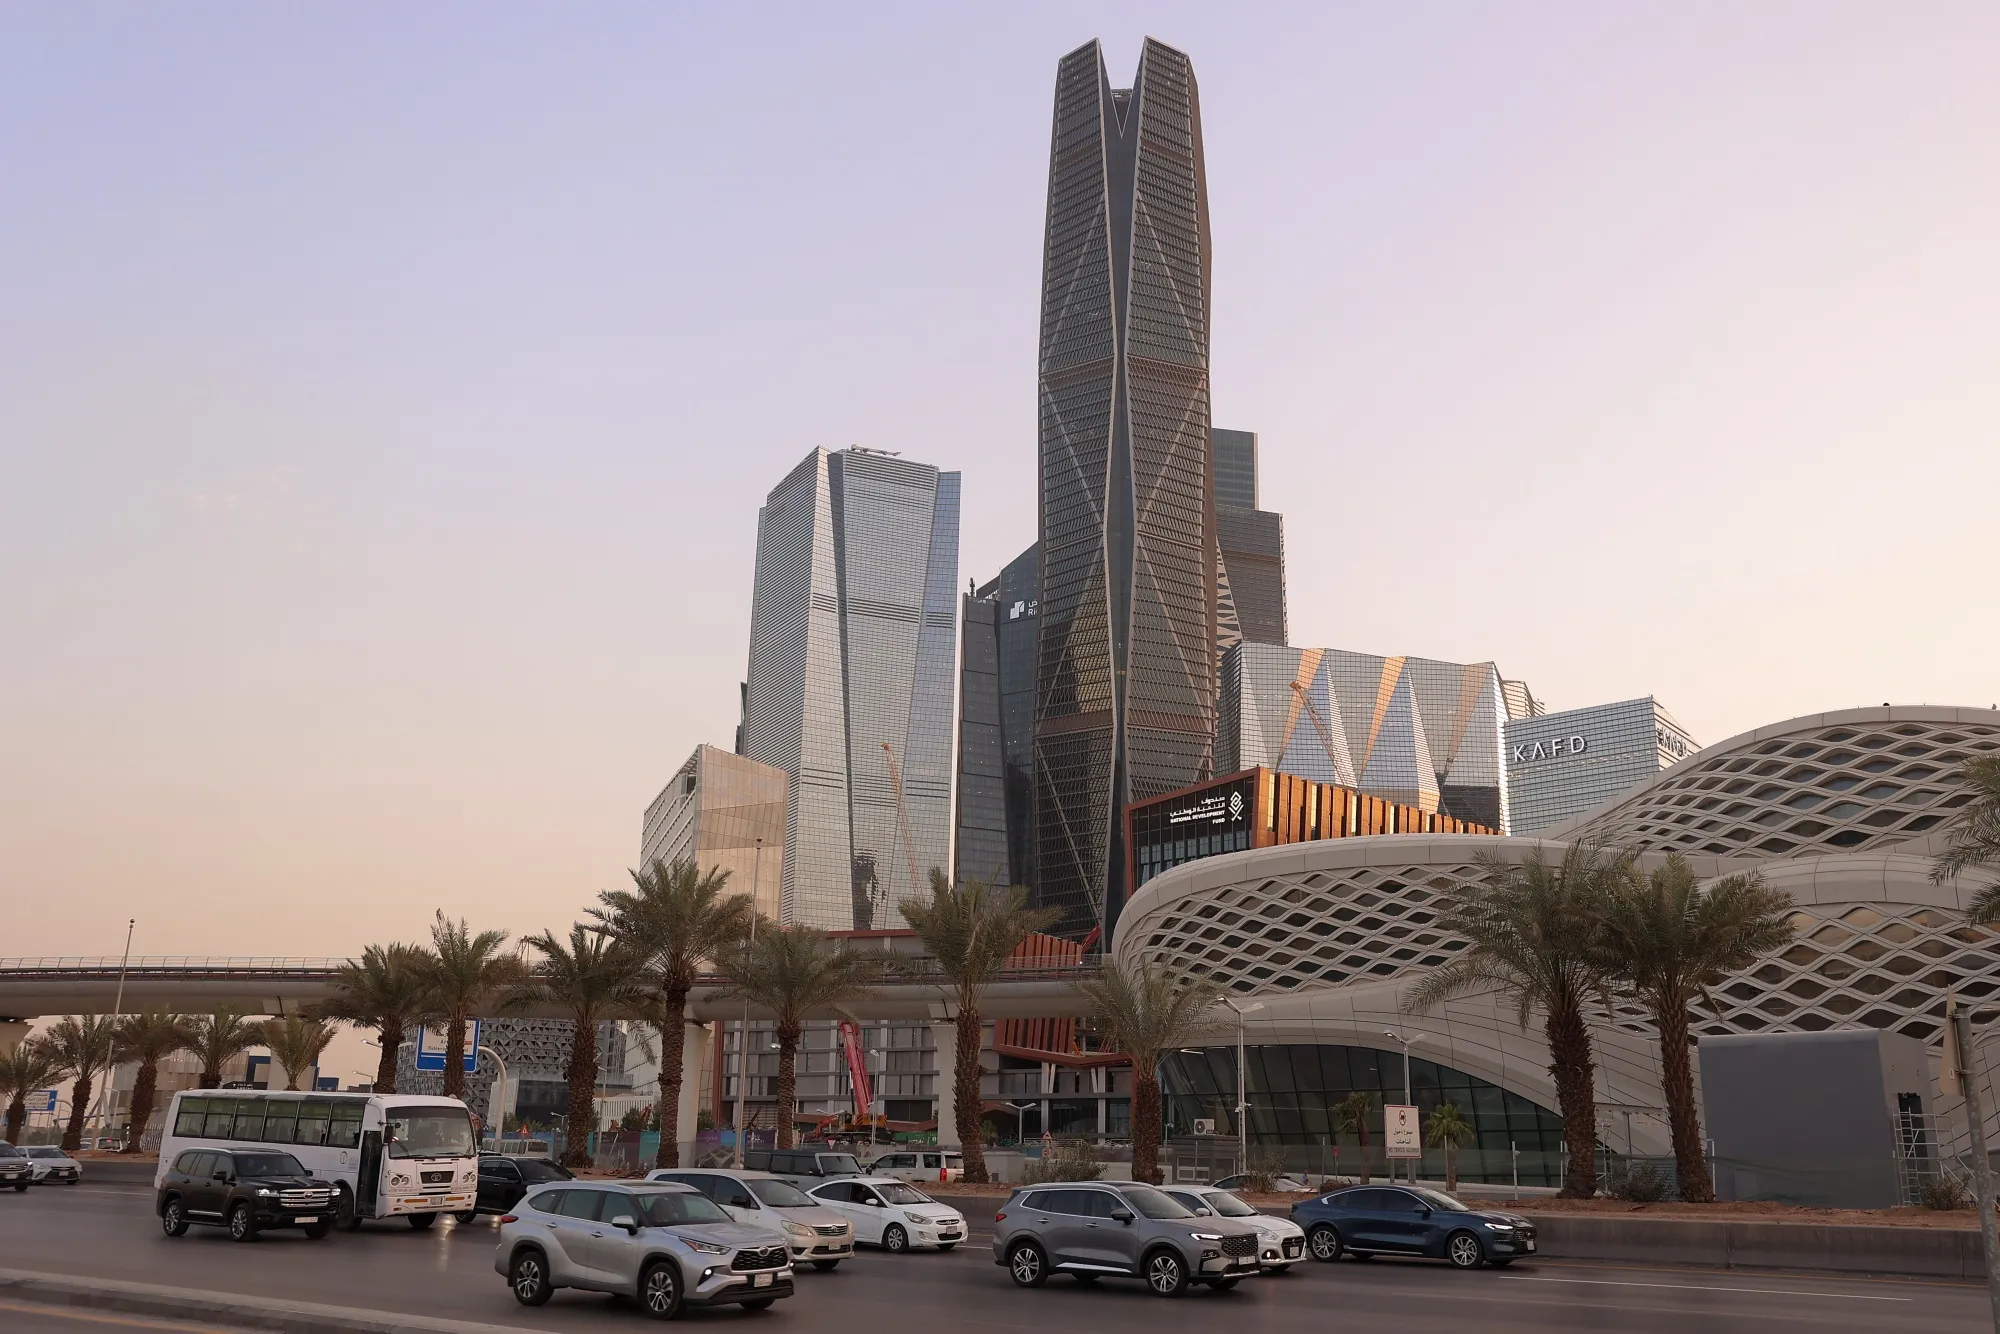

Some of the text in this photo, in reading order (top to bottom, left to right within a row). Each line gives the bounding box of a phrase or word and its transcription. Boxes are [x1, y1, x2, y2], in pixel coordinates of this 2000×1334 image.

[1514, 735, 1586, 762] KAFD
[1170, 810, 1225, 824] NATIONAL DEVELOPMENT
